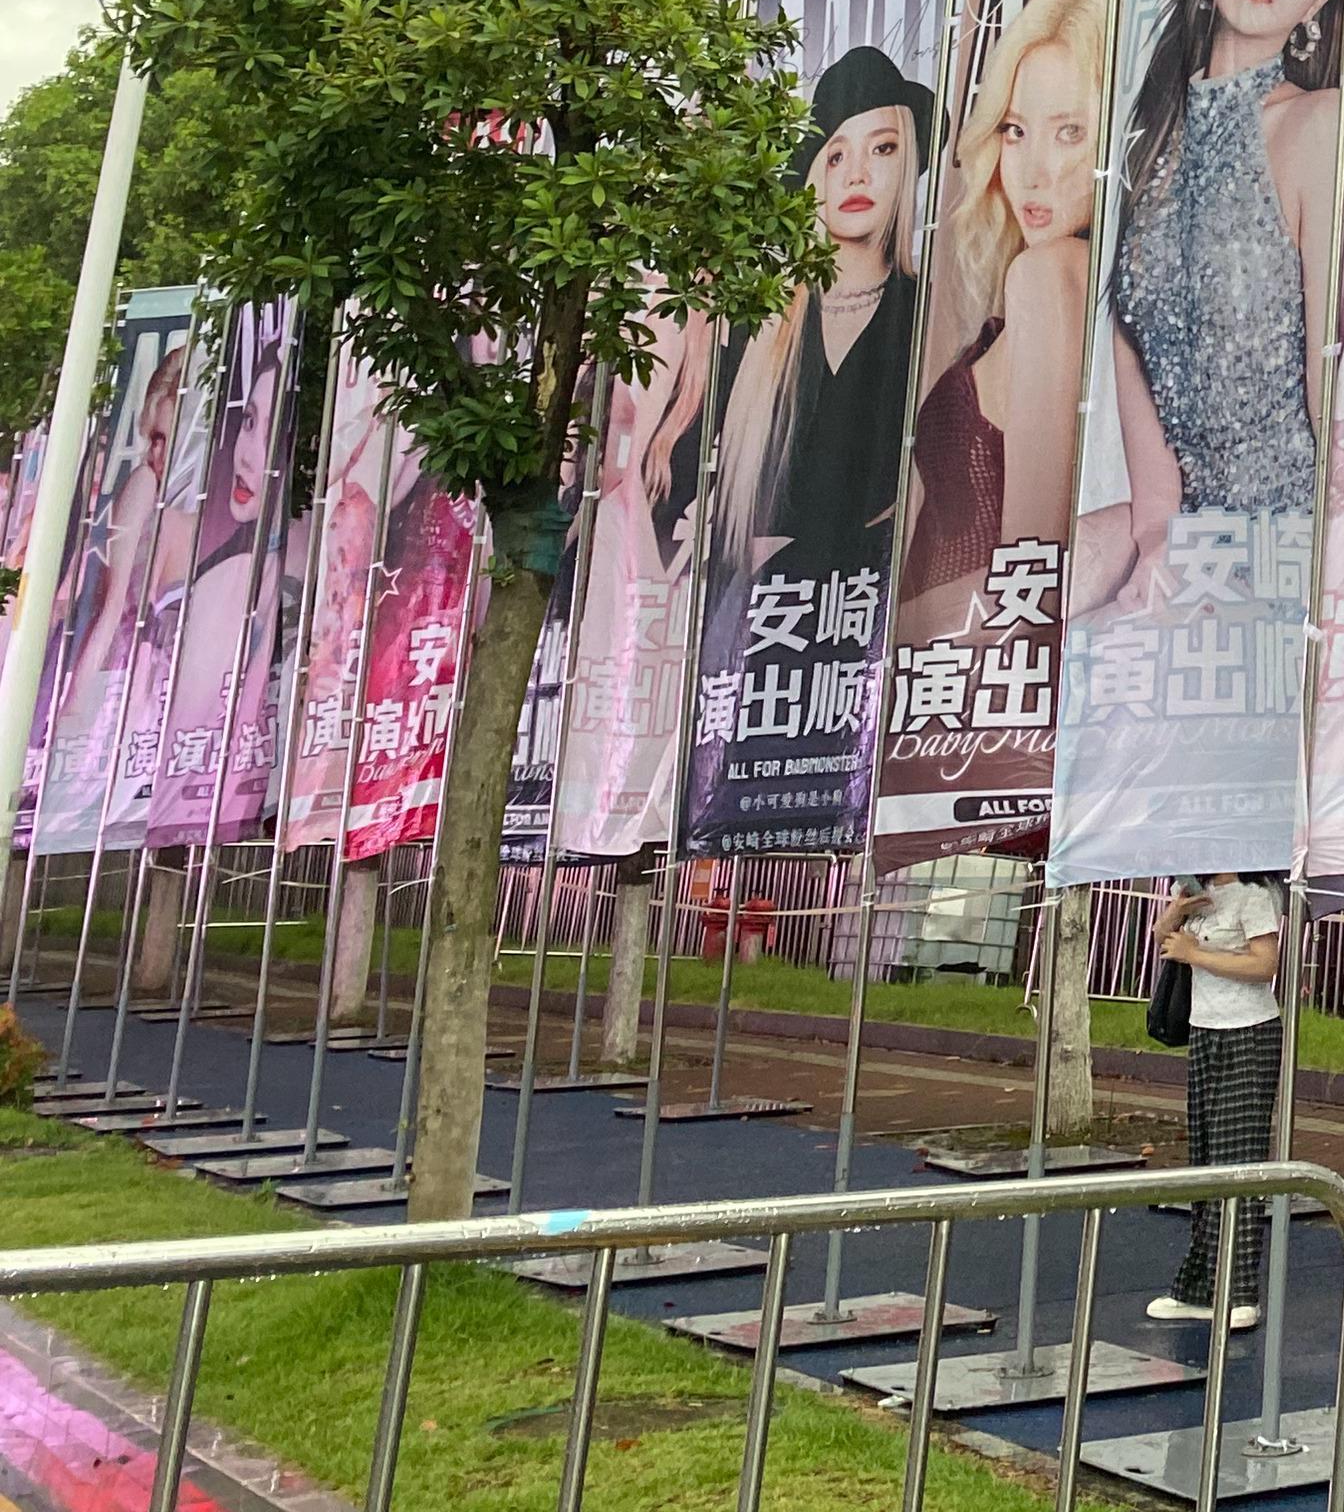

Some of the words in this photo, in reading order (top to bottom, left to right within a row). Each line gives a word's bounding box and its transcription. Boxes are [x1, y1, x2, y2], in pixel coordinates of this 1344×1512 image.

[743, 567, 880, 657] 安崎
[985, 540, 1067, 629] 安
[696, 659, 872, 749] 演出顺
[1063, 617, 1305, 726] 演出顺
[728, 762, 749, 780] ALL
[753, 759, 781, 778] FOR
[978, 799, 1015, 817] ALL
